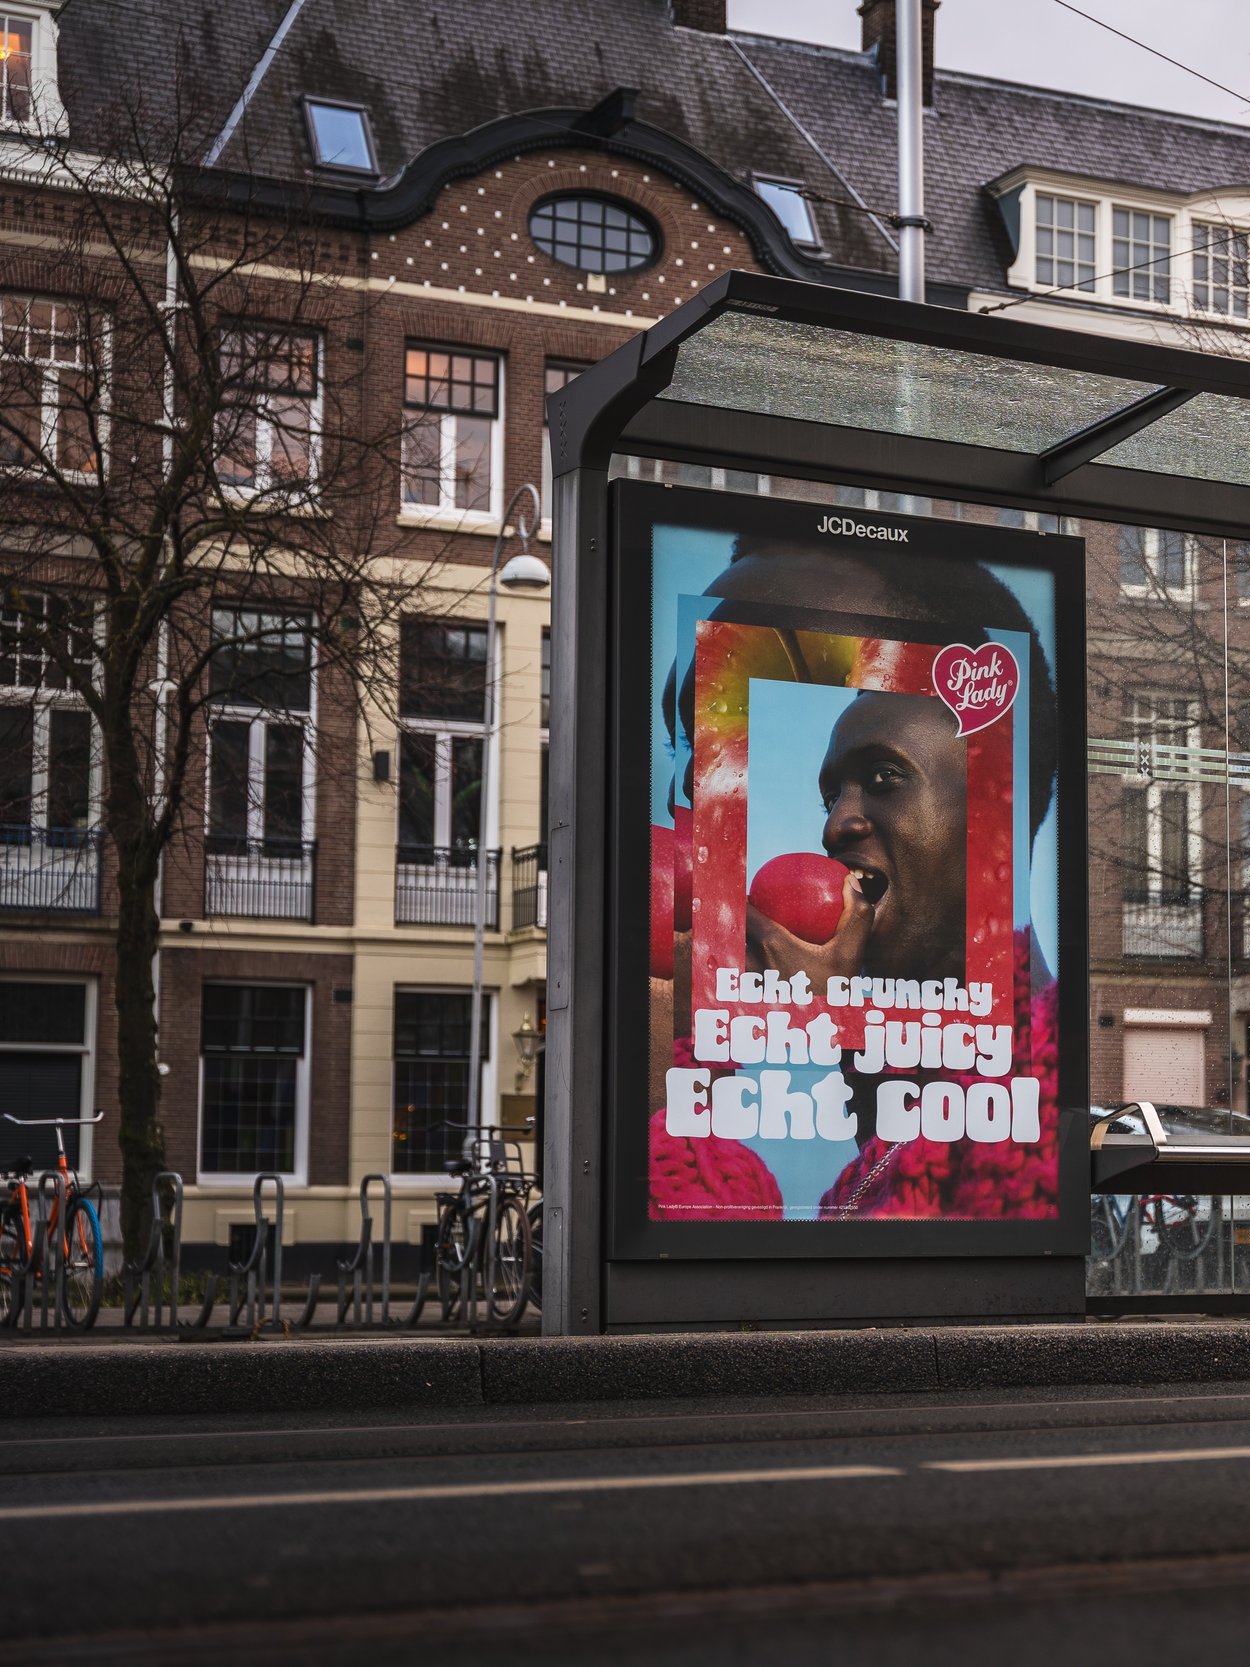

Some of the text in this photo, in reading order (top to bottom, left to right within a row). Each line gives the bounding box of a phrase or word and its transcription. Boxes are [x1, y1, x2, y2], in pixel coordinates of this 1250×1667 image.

[817, 516, 909, 542] JCDecaux
[947, 652, 1003, 691] Pink
[716, 967, 993, 1017] Echt crunchy
[694, 1008, 1013, 1077] Echt juicy
[665, 1067, 1041, 1143] Echt cool
